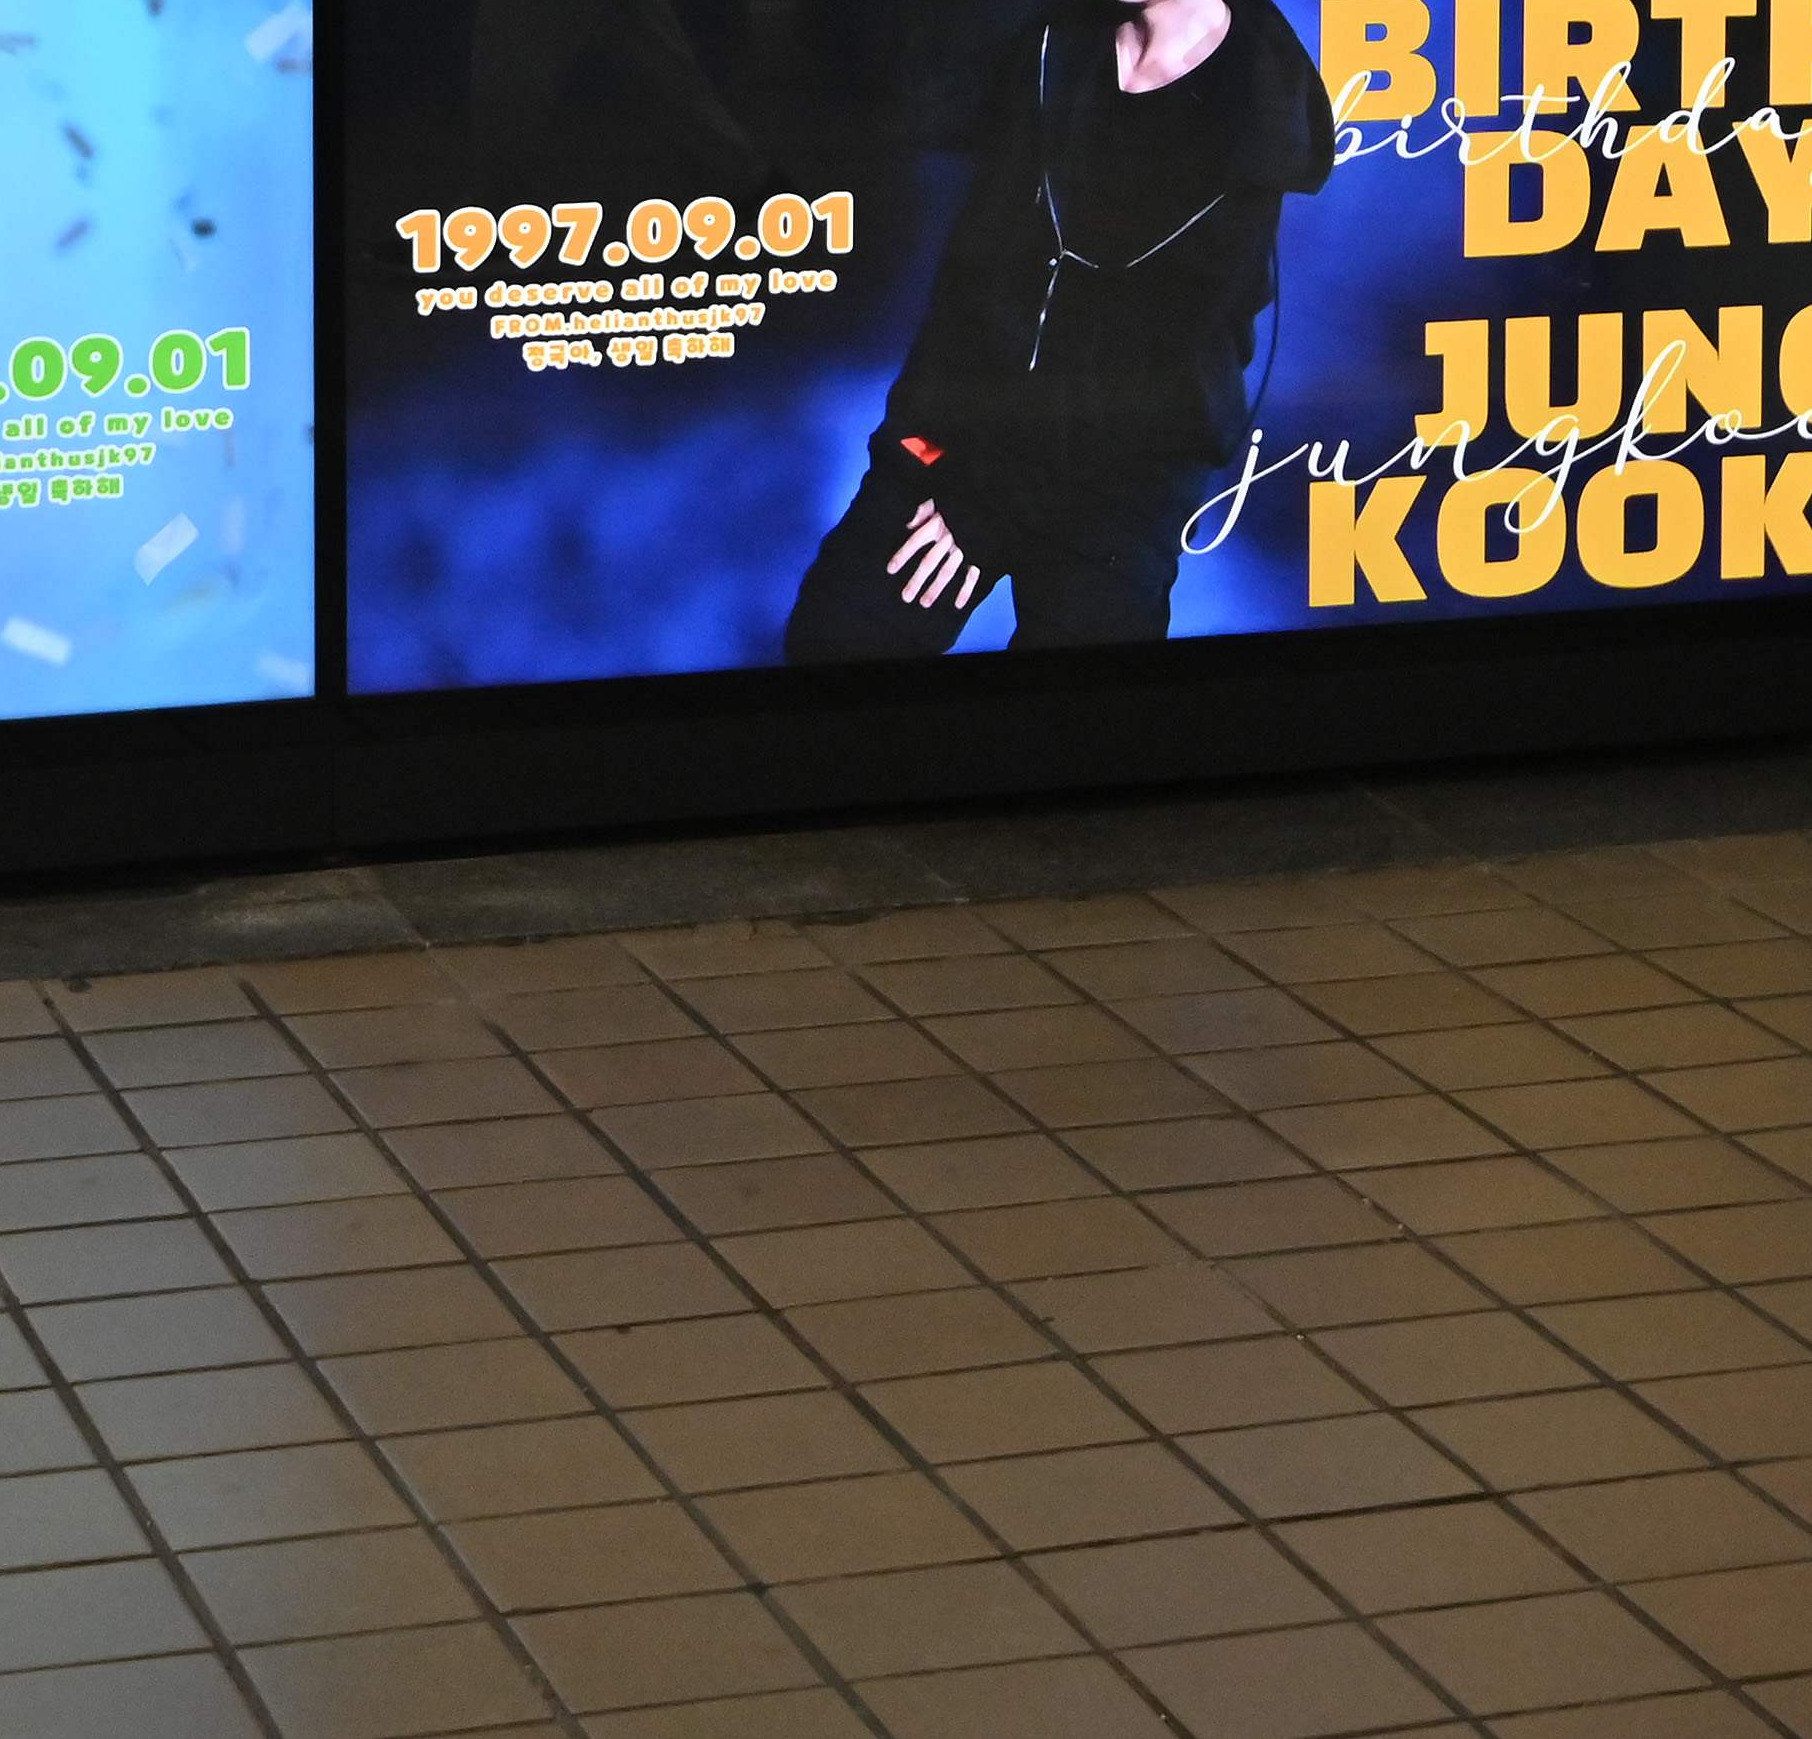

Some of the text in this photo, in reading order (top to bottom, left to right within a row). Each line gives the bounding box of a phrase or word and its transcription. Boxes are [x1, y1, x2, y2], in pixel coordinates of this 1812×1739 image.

[395, 191, 855, 273] 1997.09.01
[416, 267, 837, 316] you deserve all of my love
[607, 336, 657, 367] 생일
[3, 413, 48, 440] all
[57, 410, 94, 436] of
[104, 411, 150, 438] my
[162, 406, 233, 432] love
